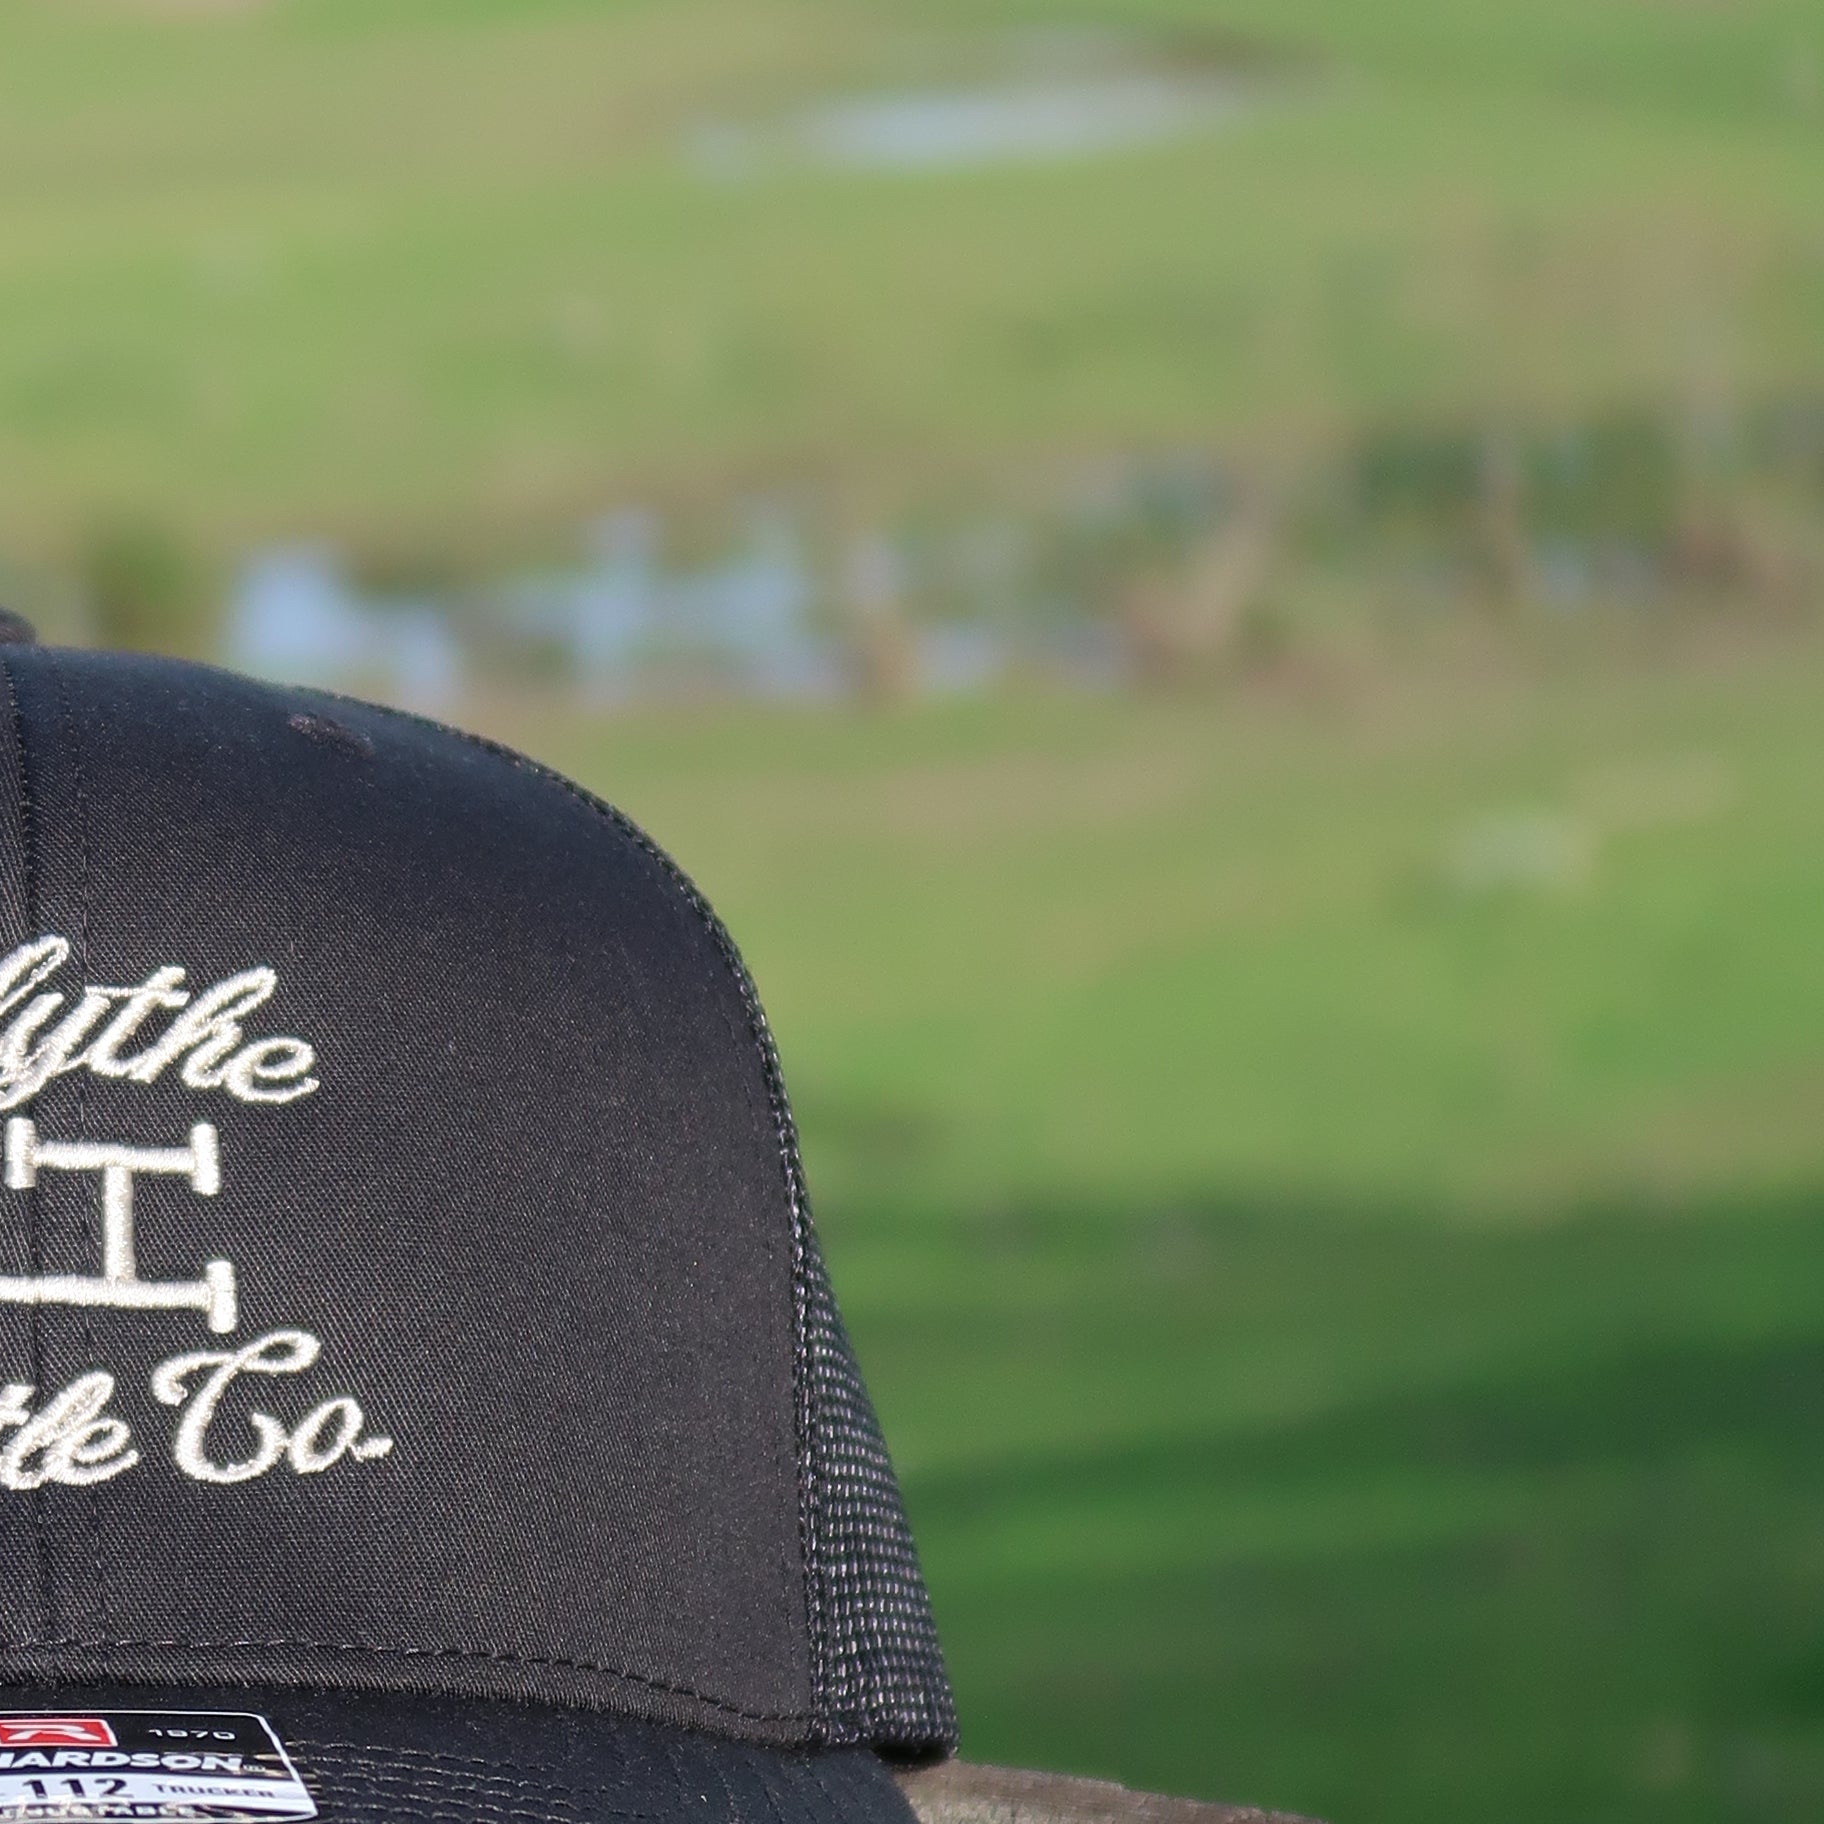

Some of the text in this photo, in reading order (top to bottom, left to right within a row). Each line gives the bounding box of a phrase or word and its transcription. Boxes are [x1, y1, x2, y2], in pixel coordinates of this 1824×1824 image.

[151, 1330, 393, 1483] Co.
[22, 1778, 134, 1799] 112
[152, 1783, 275, 1798] TRUCKER
